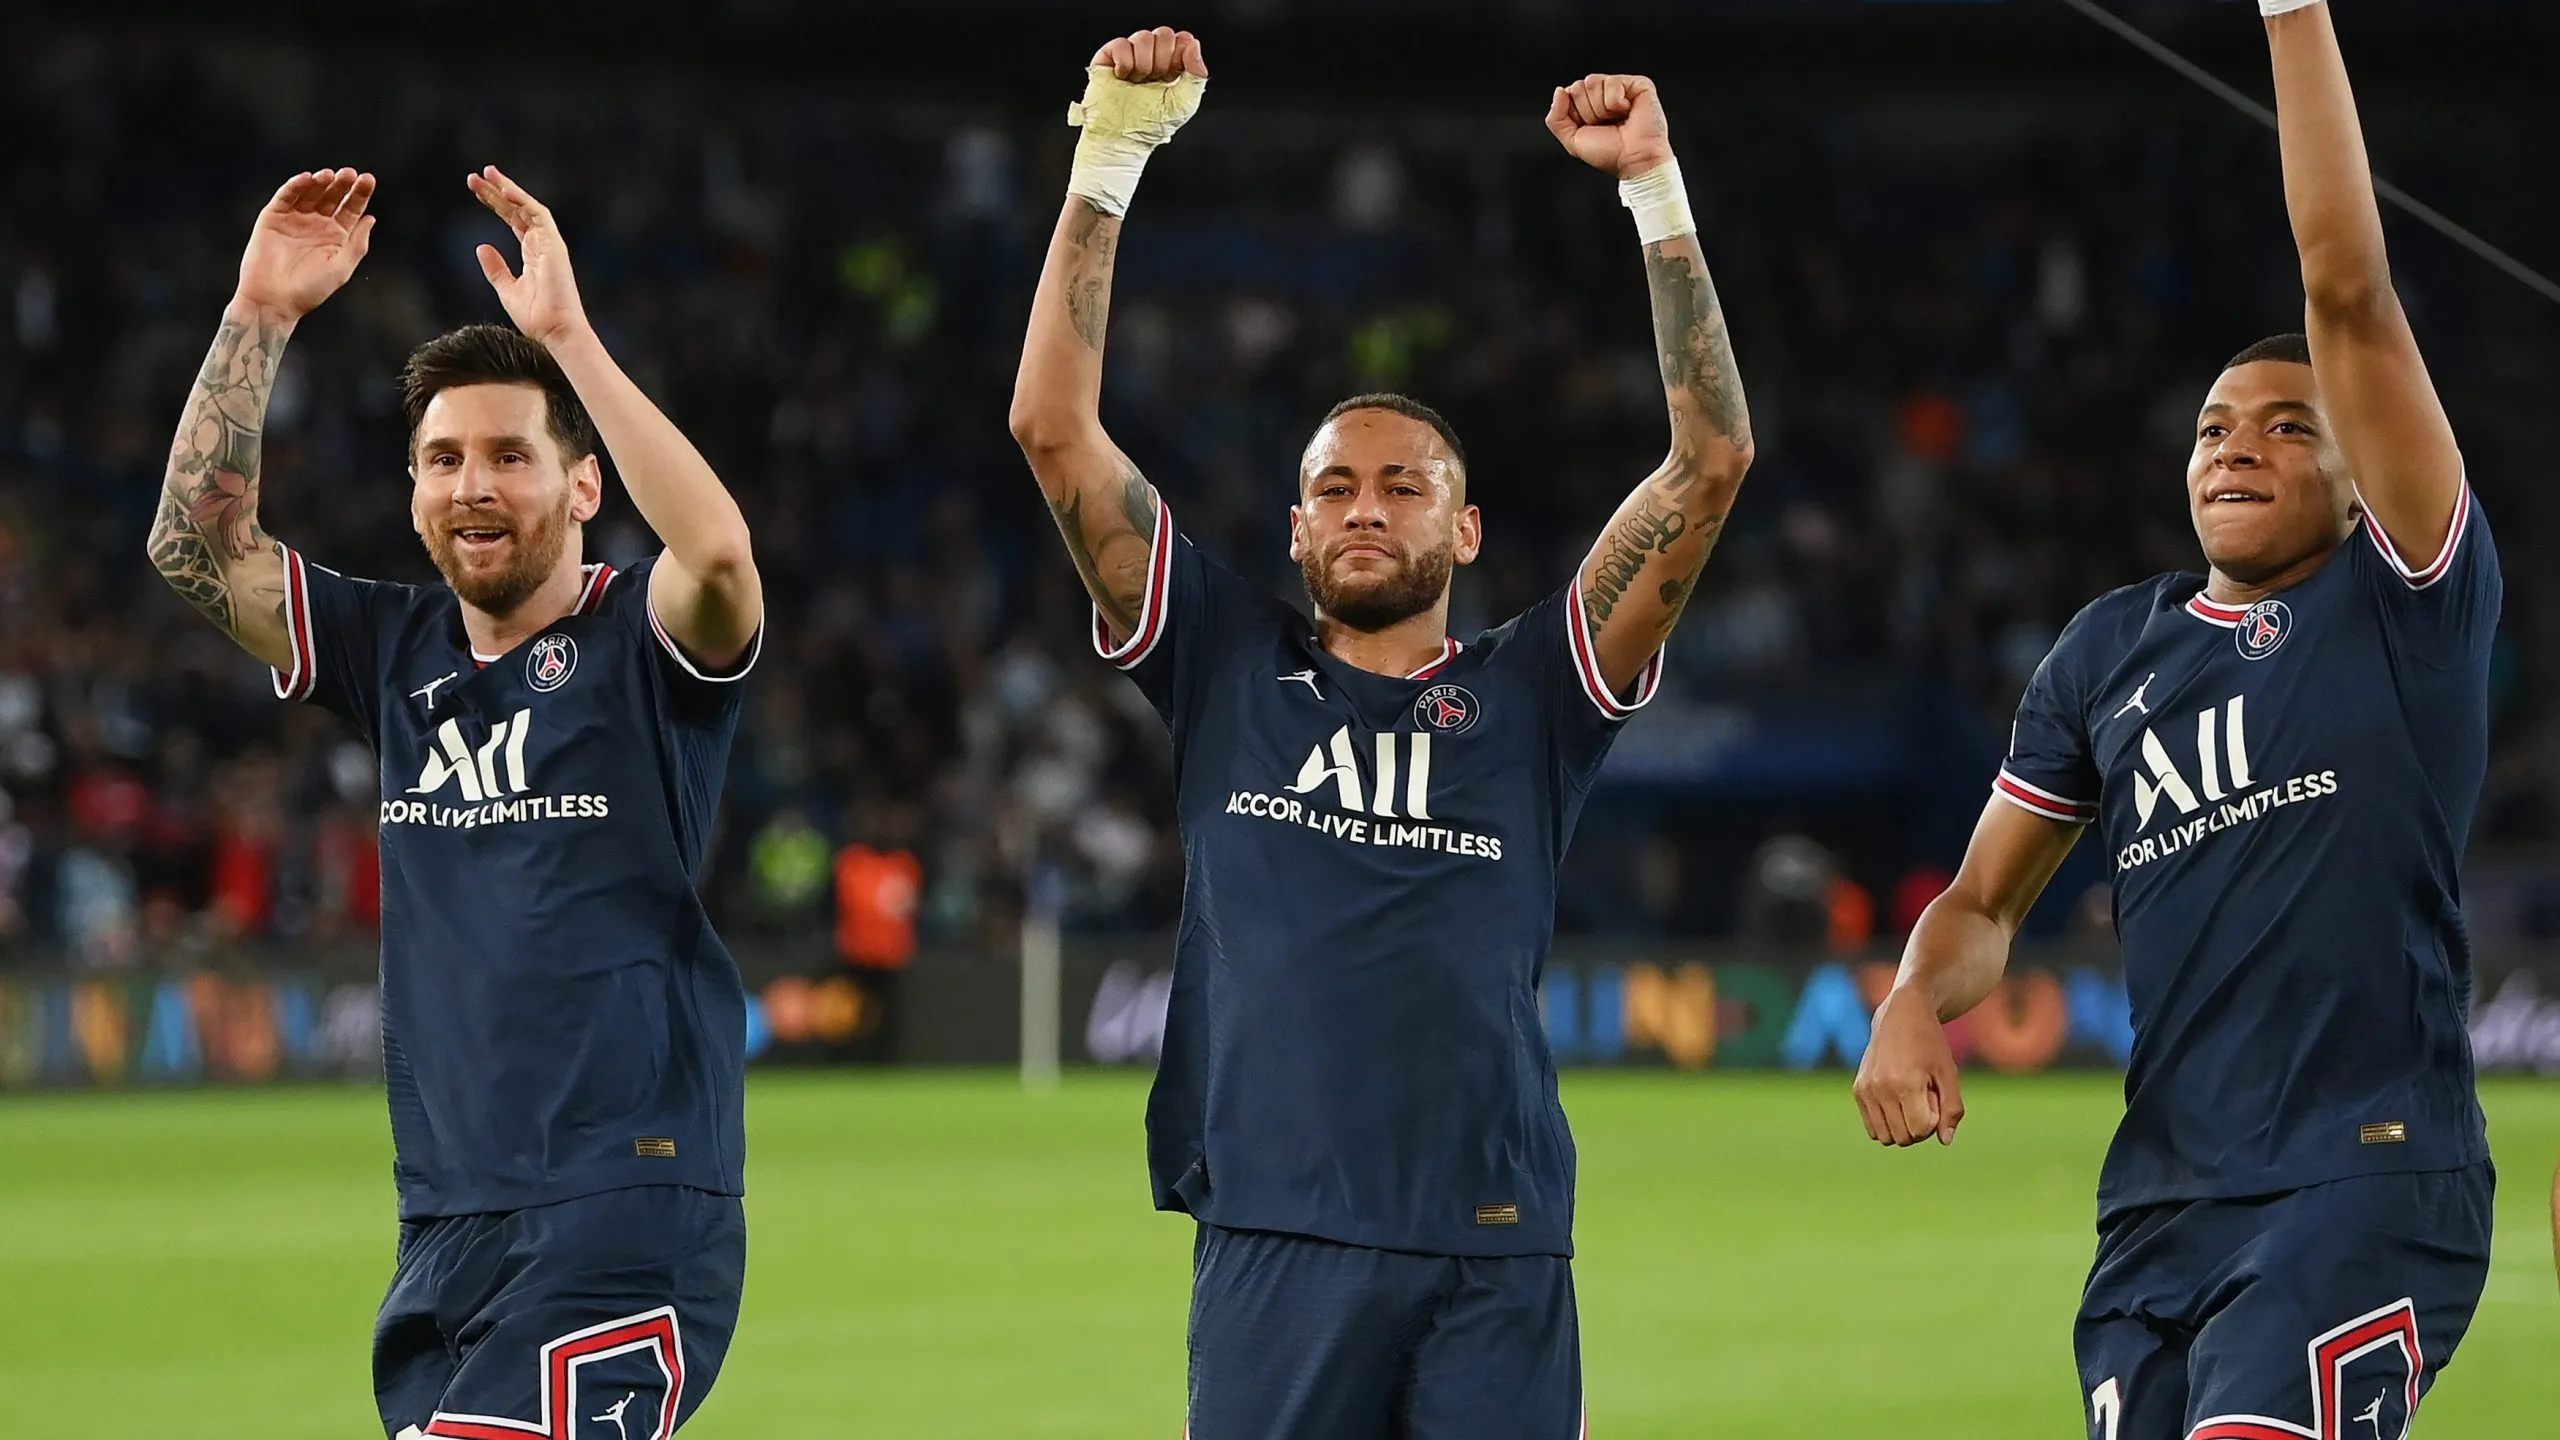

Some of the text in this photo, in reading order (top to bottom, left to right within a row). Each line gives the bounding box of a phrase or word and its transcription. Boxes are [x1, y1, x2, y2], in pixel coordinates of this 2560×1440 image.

[2241, 603, 2279, 628] PARIS
[533, 637, 568, 656] PARIS
[1418, 687, 1458, 710] PARIS
[431, 803, 479, 829] LIVE
[479, 794, 609, 825] LIMITLESS
[1225, 791, 1502, 861] ACCOR LIVE LIMITLESS
[2158, 817, 2207, 856] LIVE
[2208, 770, 2338, 833] LIMITLESS
